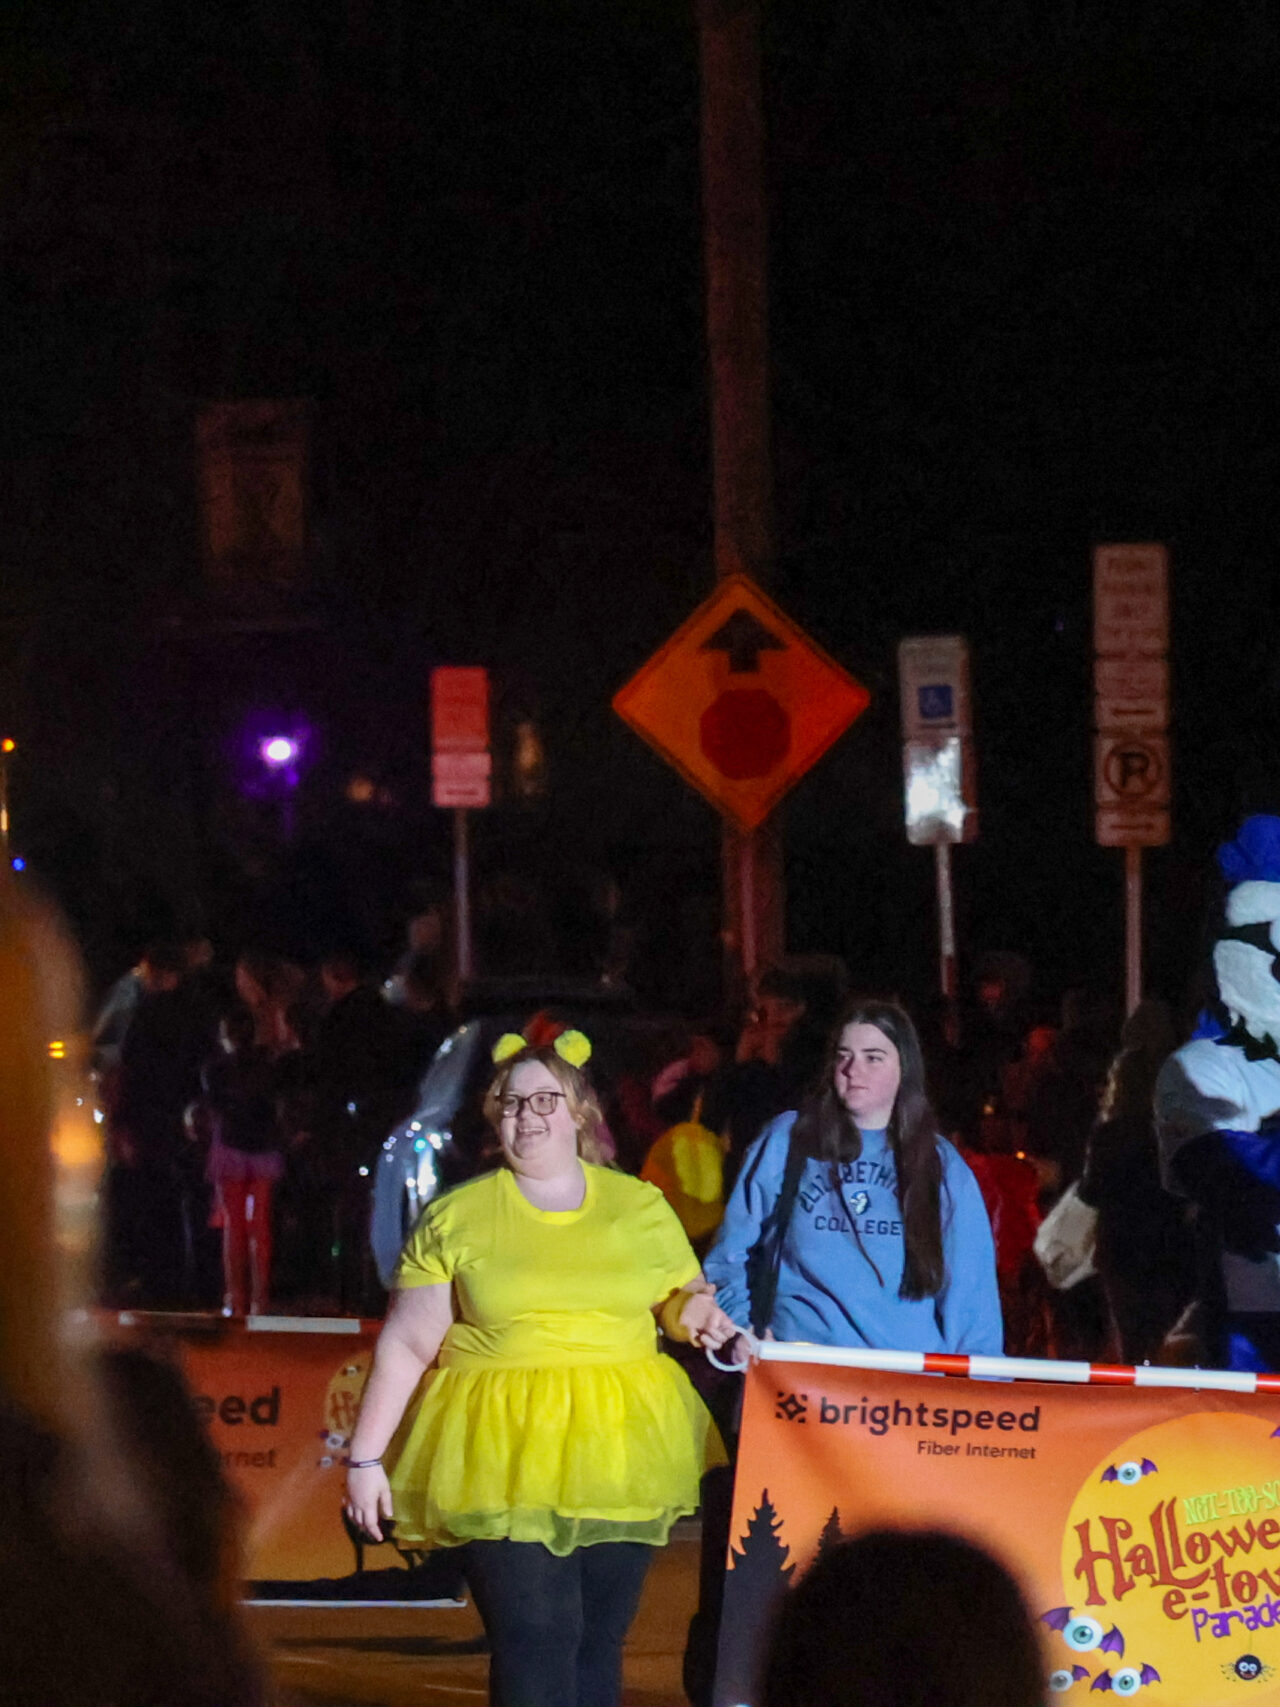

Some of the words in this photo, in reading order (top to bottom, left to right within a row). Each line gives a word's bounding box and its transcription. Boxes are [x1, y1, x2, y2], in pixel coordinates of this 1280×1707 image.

[820, 1396, 1041, 1436] brightspeed
[917, 1440, 961, 1456] Fiber
[966, 1442, 1036, 1460] Internet
